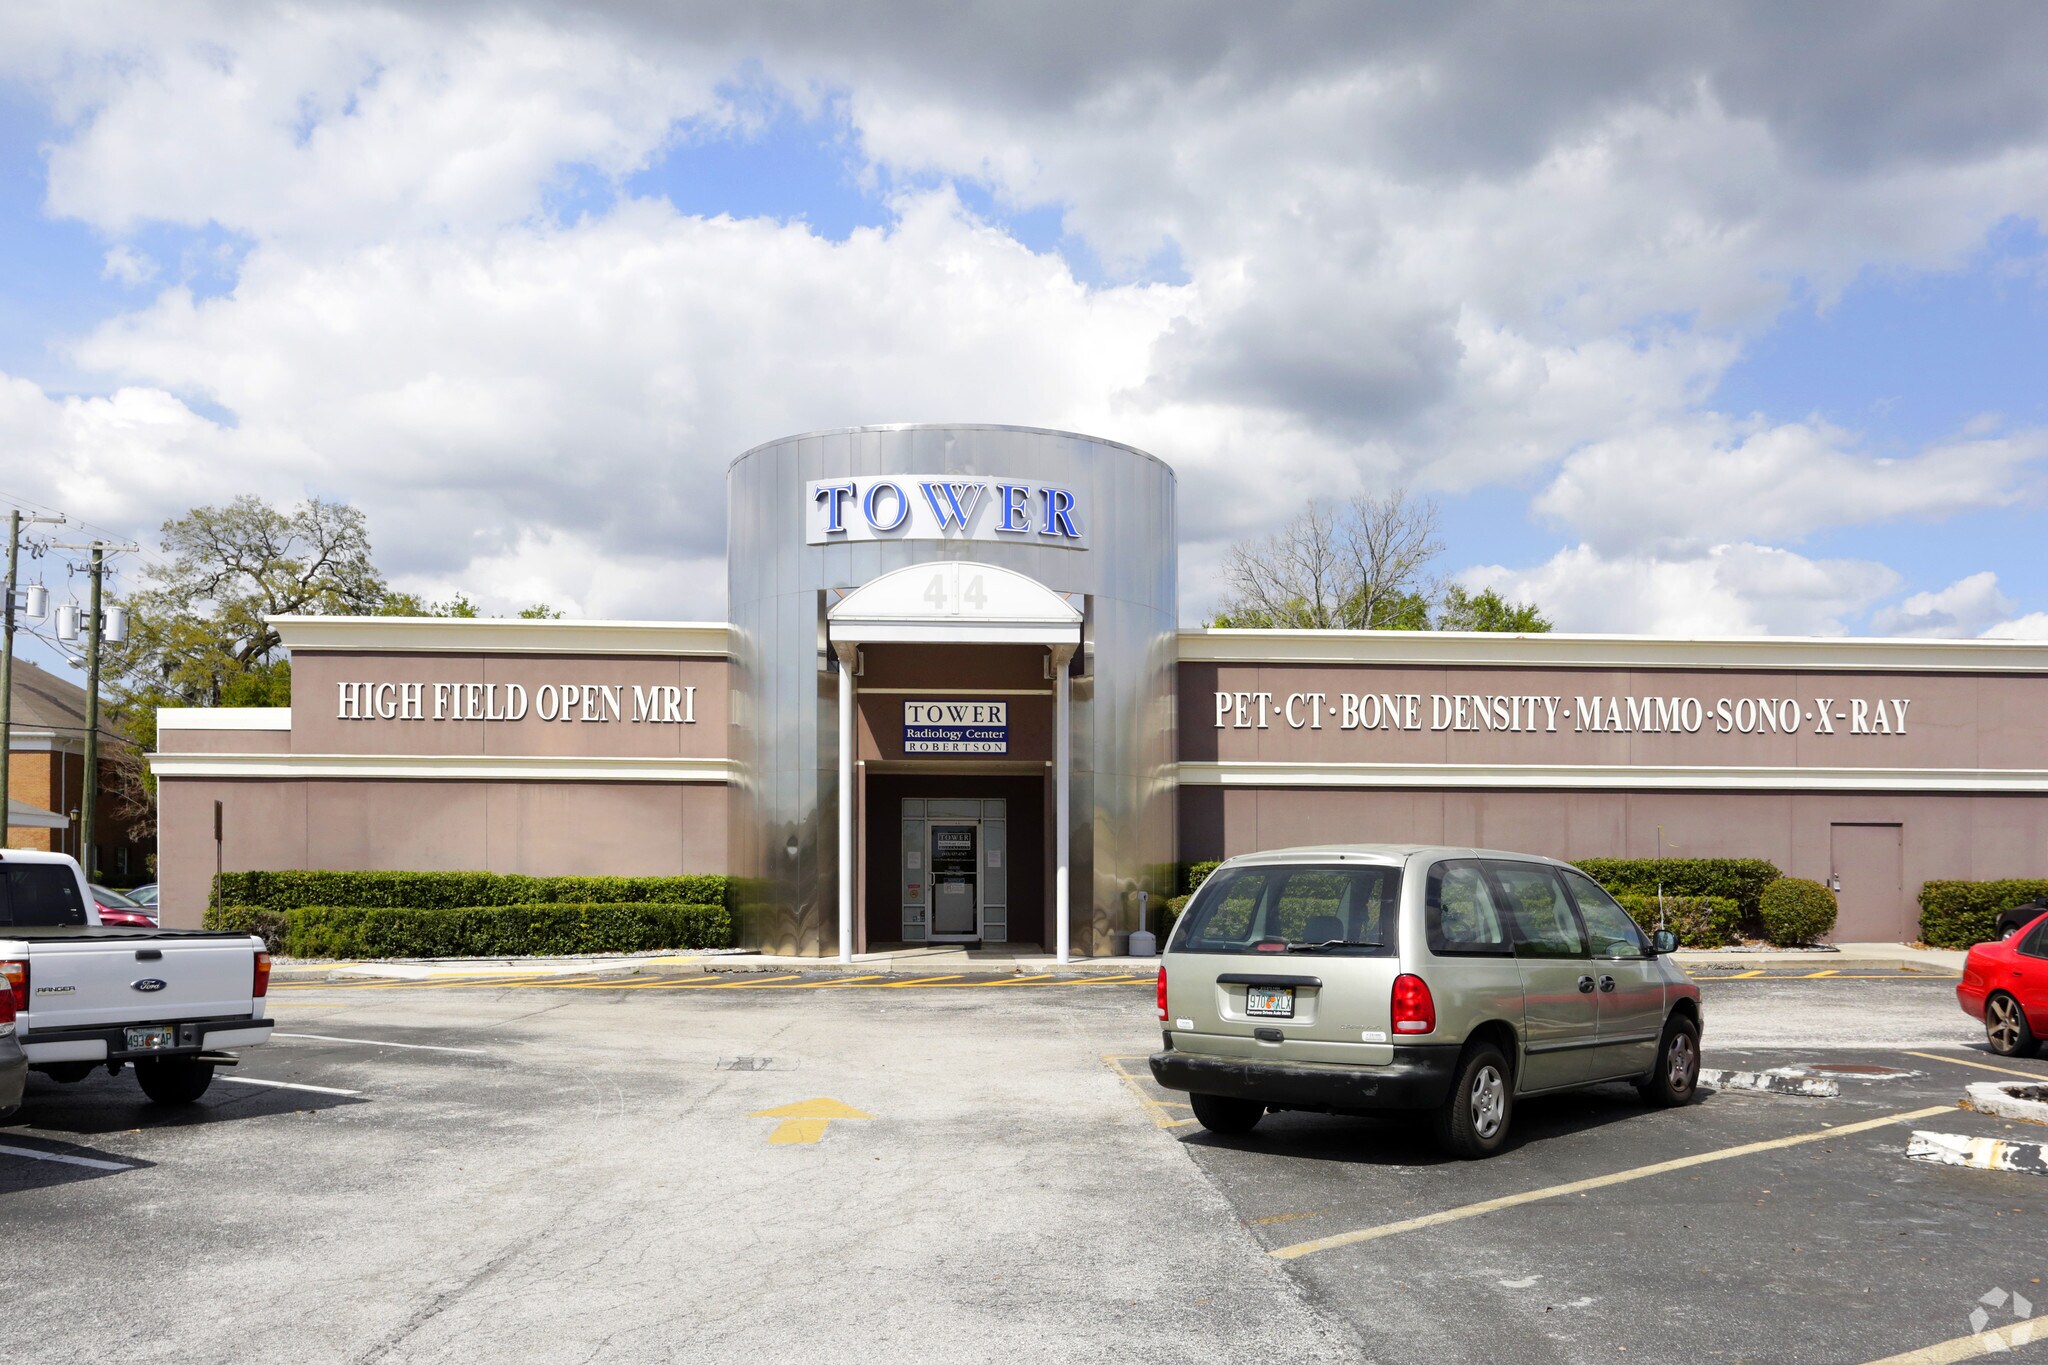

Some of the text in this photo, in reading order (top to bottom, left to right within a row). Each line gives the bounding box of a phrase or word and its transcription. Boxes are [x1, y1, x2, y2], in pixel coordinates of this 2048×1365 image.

[814, 481, 1083, 538] TOWER
[336, 682, 696, 722] HIGH FIELD OPEN MRI
[908, 705, 1002, 723] TOWER
[907, 728, 1005, 741] Radiology Center
[909, 742, 1003, 752] ROBERTSON
[36, 985, 76, 993] RANGER
[140, 980, 161, 990] Ford
[1250, 994, 1266, 1009] 970
[127, 1034, 145, 1048] 493
